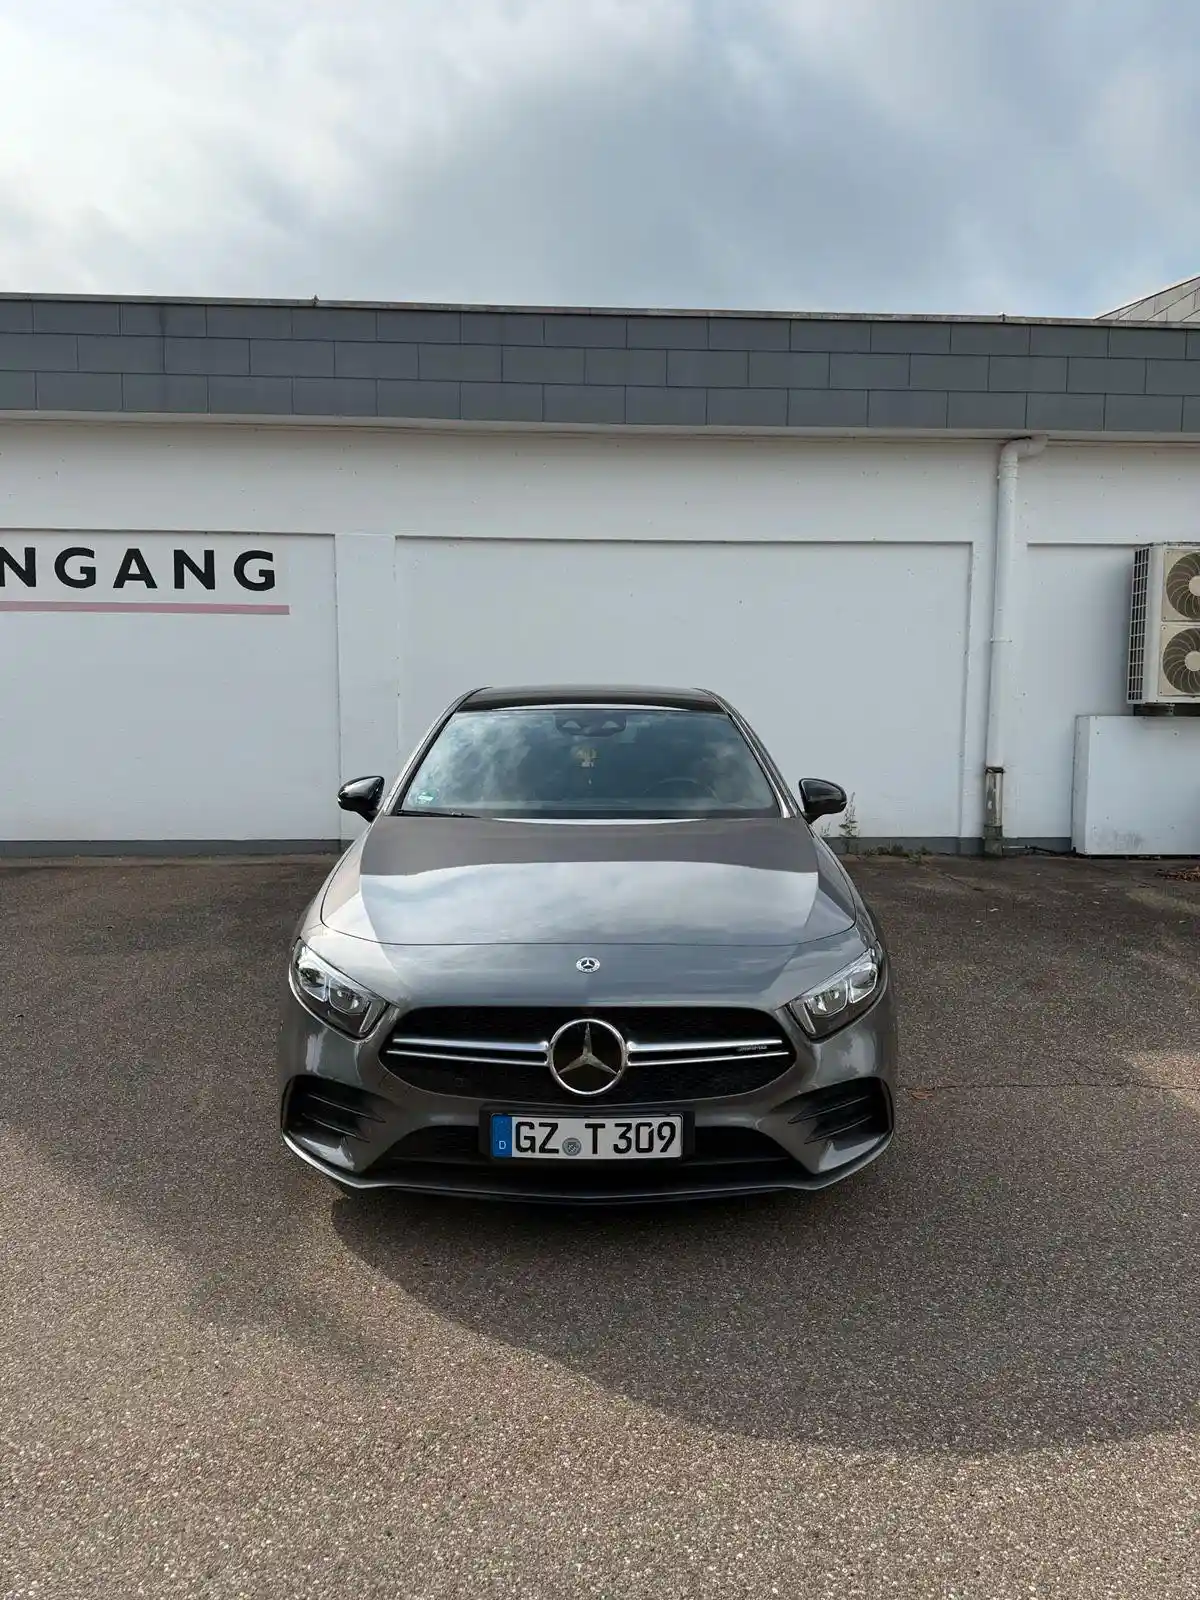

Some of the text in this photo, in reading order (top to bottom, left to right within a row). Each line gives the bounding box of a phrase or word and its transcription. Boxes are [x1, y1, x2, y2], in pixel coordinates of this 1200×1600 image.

[0, 546, 276, 592] NGANG
[498, 1140, 507, 1150] D
[515, 1121, 677, 1155] GZ T 309
